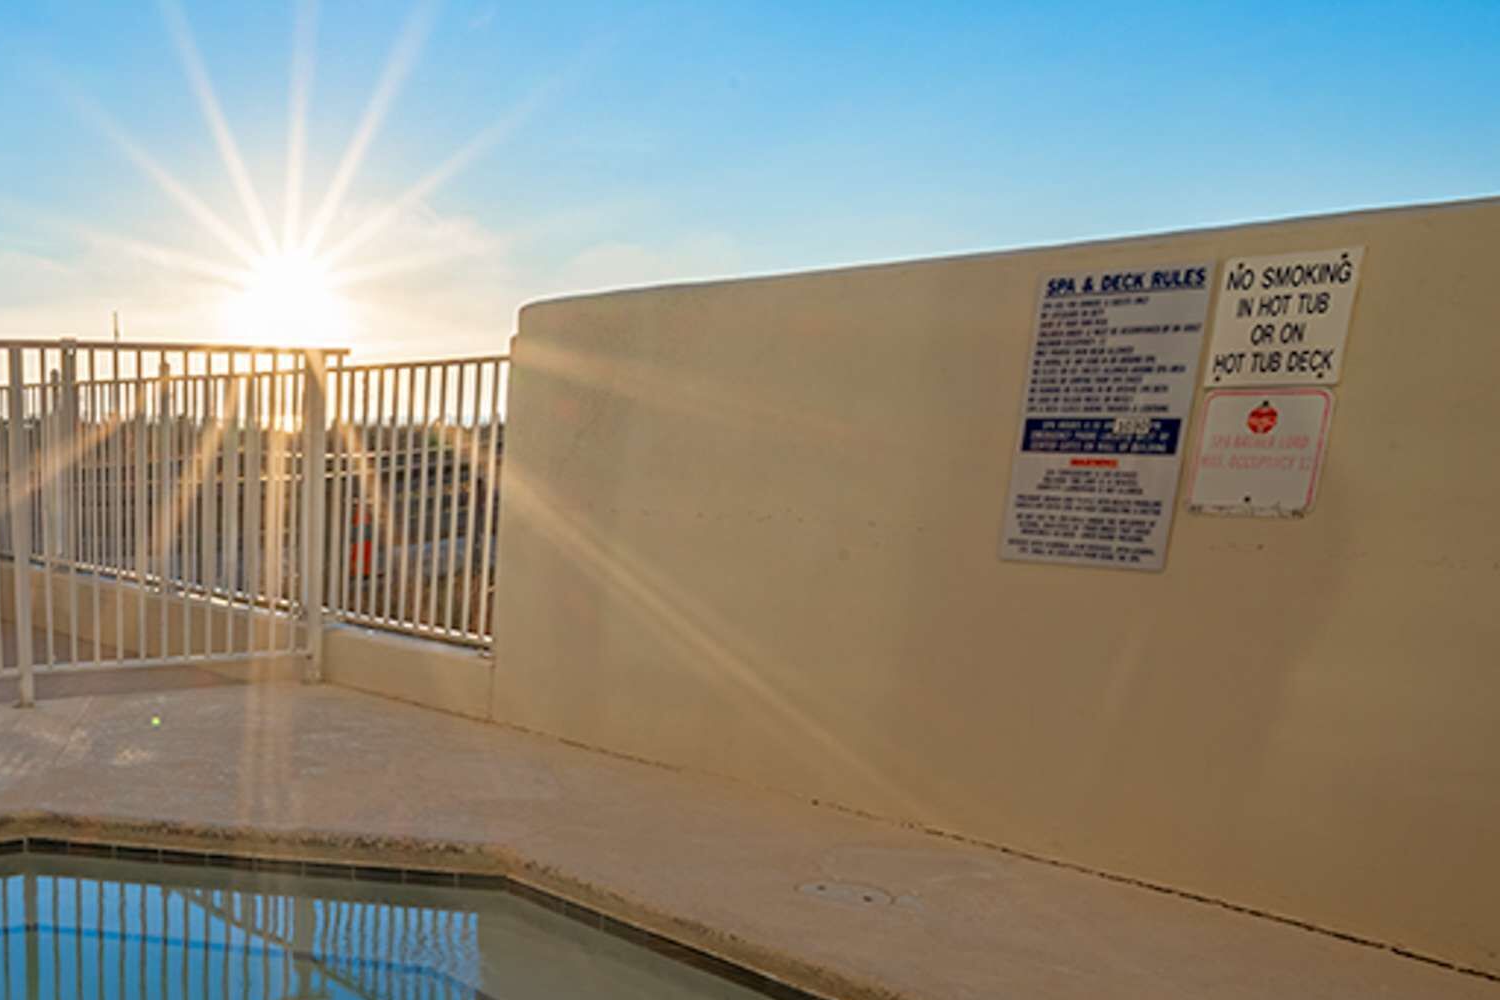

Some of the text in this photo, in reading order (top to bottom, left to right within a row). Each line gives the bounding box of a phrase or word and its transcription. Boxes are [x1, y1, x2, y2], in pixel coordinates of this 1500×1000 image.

[1045, 278, 1076, 297] SPA
[1101, 272, 1146, 292] DECK
[1151, 267, 1206, 288] RULES
[1226, 261, 1352, 290] NO SMOKING
[1236, 292, 1331, 317] IN HOT TUB
[1251, 322, 1307, 346] OR ON
[1213, 352, 1246, 374] HOT
[1251, 351, 1282, 373] TUB
[1286, 349, 1334, 371] DECK
